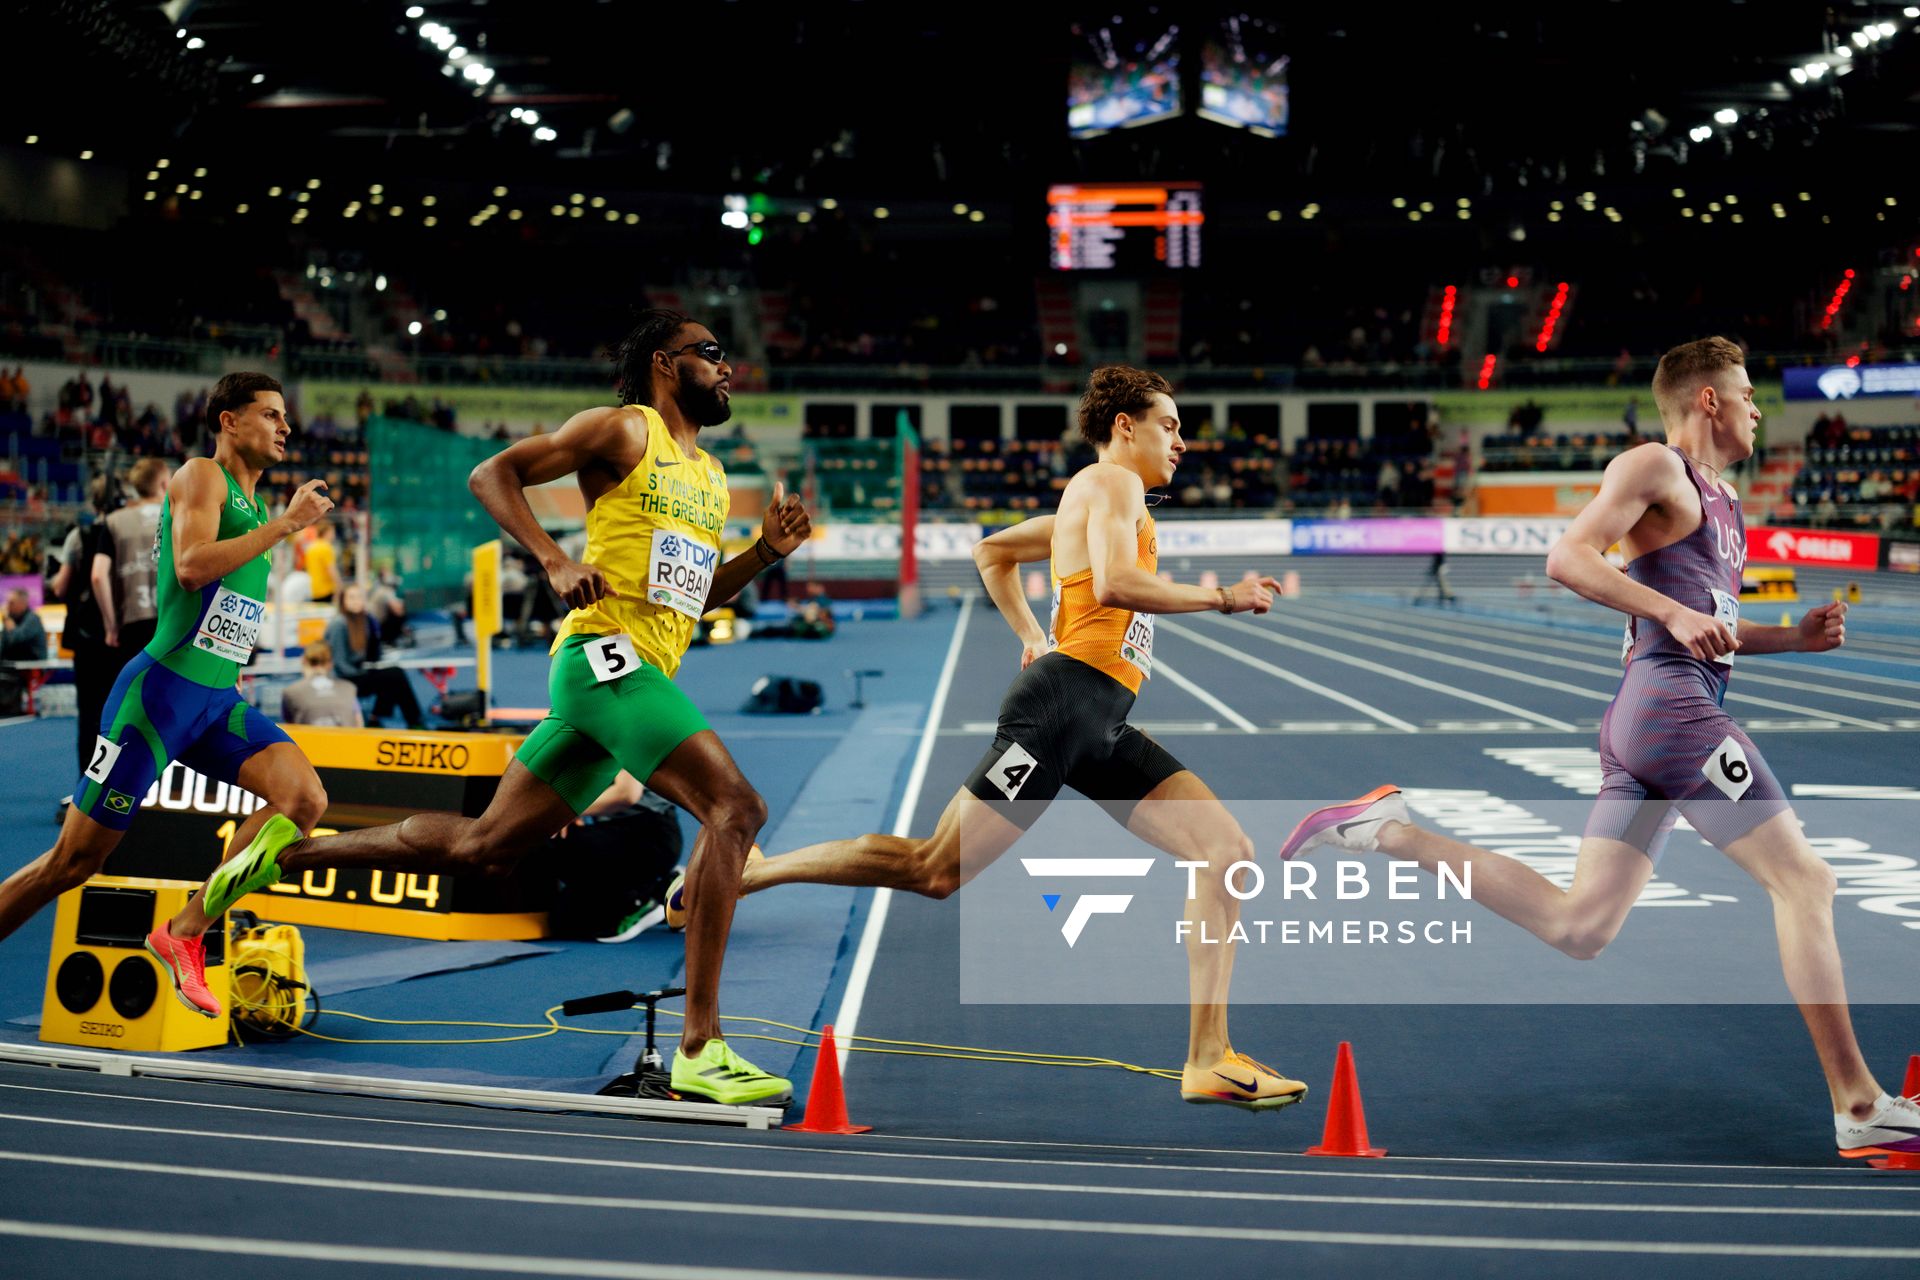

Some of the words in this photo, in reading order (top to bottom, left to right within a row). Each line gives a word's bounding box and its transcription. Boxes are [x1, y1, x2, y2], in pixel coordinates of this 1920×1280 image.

[640, 492, 668, 515] THE
[1312, 525, 1366, 549] TDK
[1460, 523, 1567, 548] SON
[1797, 536, 1853, 561] ORLEN
[681, 538, 716, 573] TDK
[657, 561, 711, 601] ROBAN
[238, 598, 264, 623] TDK
[601, 642, 626, 673] 5
[90, 744, 107, 775] 2
[377, 740, 469, 770] SEIKO
[1719, 751, 1749, 784] 6
[1003, 763, 1032, 791] 4
[80, 1021, 125, 1037] SEIKO
